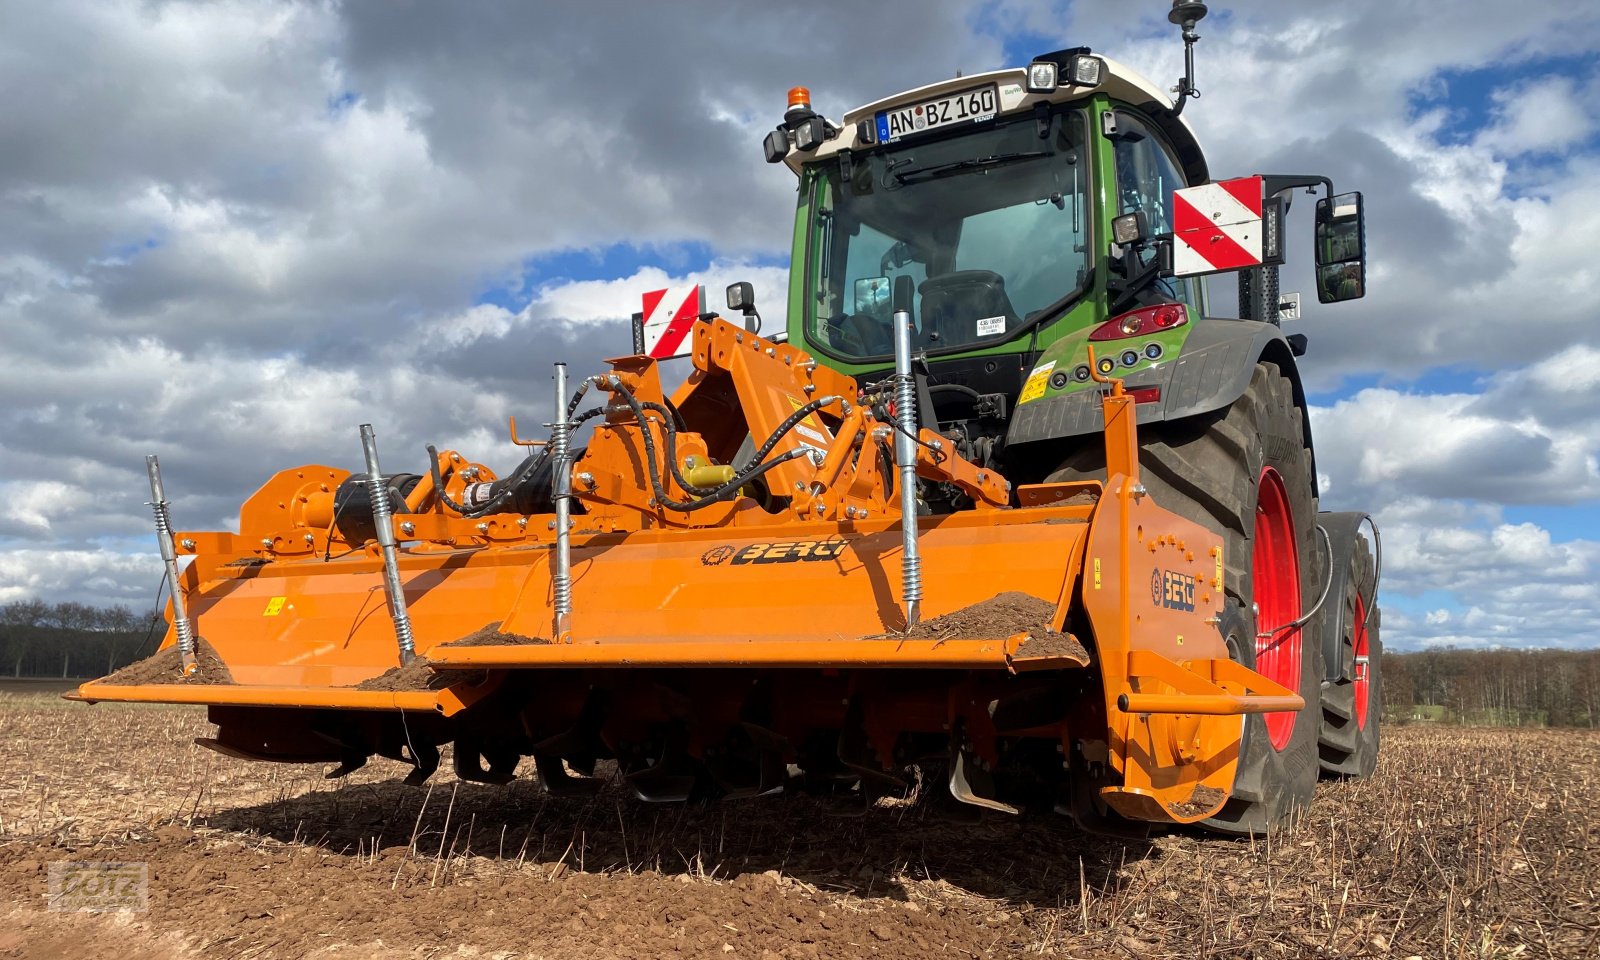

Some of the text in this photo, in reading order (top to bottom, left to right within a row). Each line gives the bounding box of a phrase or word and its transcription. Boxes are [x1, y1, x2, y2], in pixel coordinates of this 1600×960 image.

[890, 89, 994, 135] AN BZ 160
[975, 113, 995, 123] FENDT
[1163, 570, 1195, 612] BERTI
